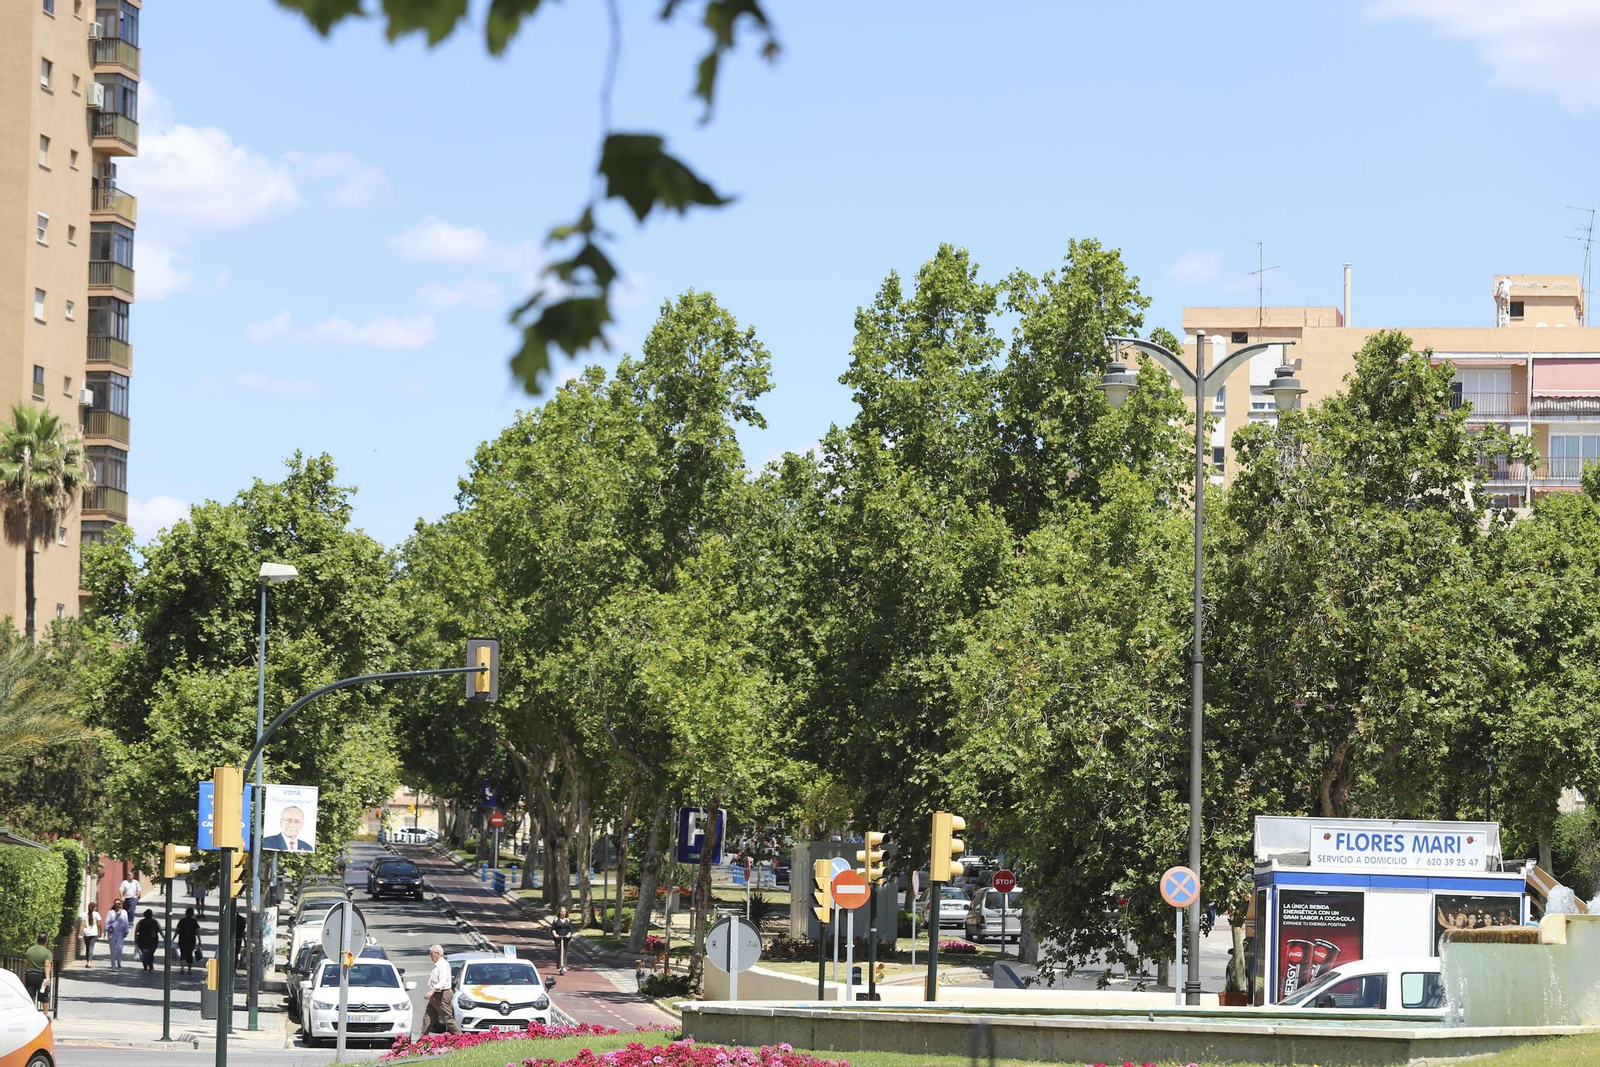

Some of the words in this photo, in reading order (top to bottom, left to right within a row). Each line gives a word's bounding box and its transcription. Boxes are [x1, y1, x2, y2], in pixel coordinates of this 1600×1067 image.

[1336, 833, 1405, 853] FLORES
[1412, 835, 1461, 854] MARI
[1317, 854, 1354, 864] SERVICIO
[1356, 856, 1362, 864] A
[1364, 856, 1408, 865] DOMICILIO
[1427, 858, 1441, 866] 620
[1444, 858, 1454, 866] 39
[1457, 858, 1466, 866] 25
[1468, 859, 1479, 867] 47
[507, 946, 514, 954] L
